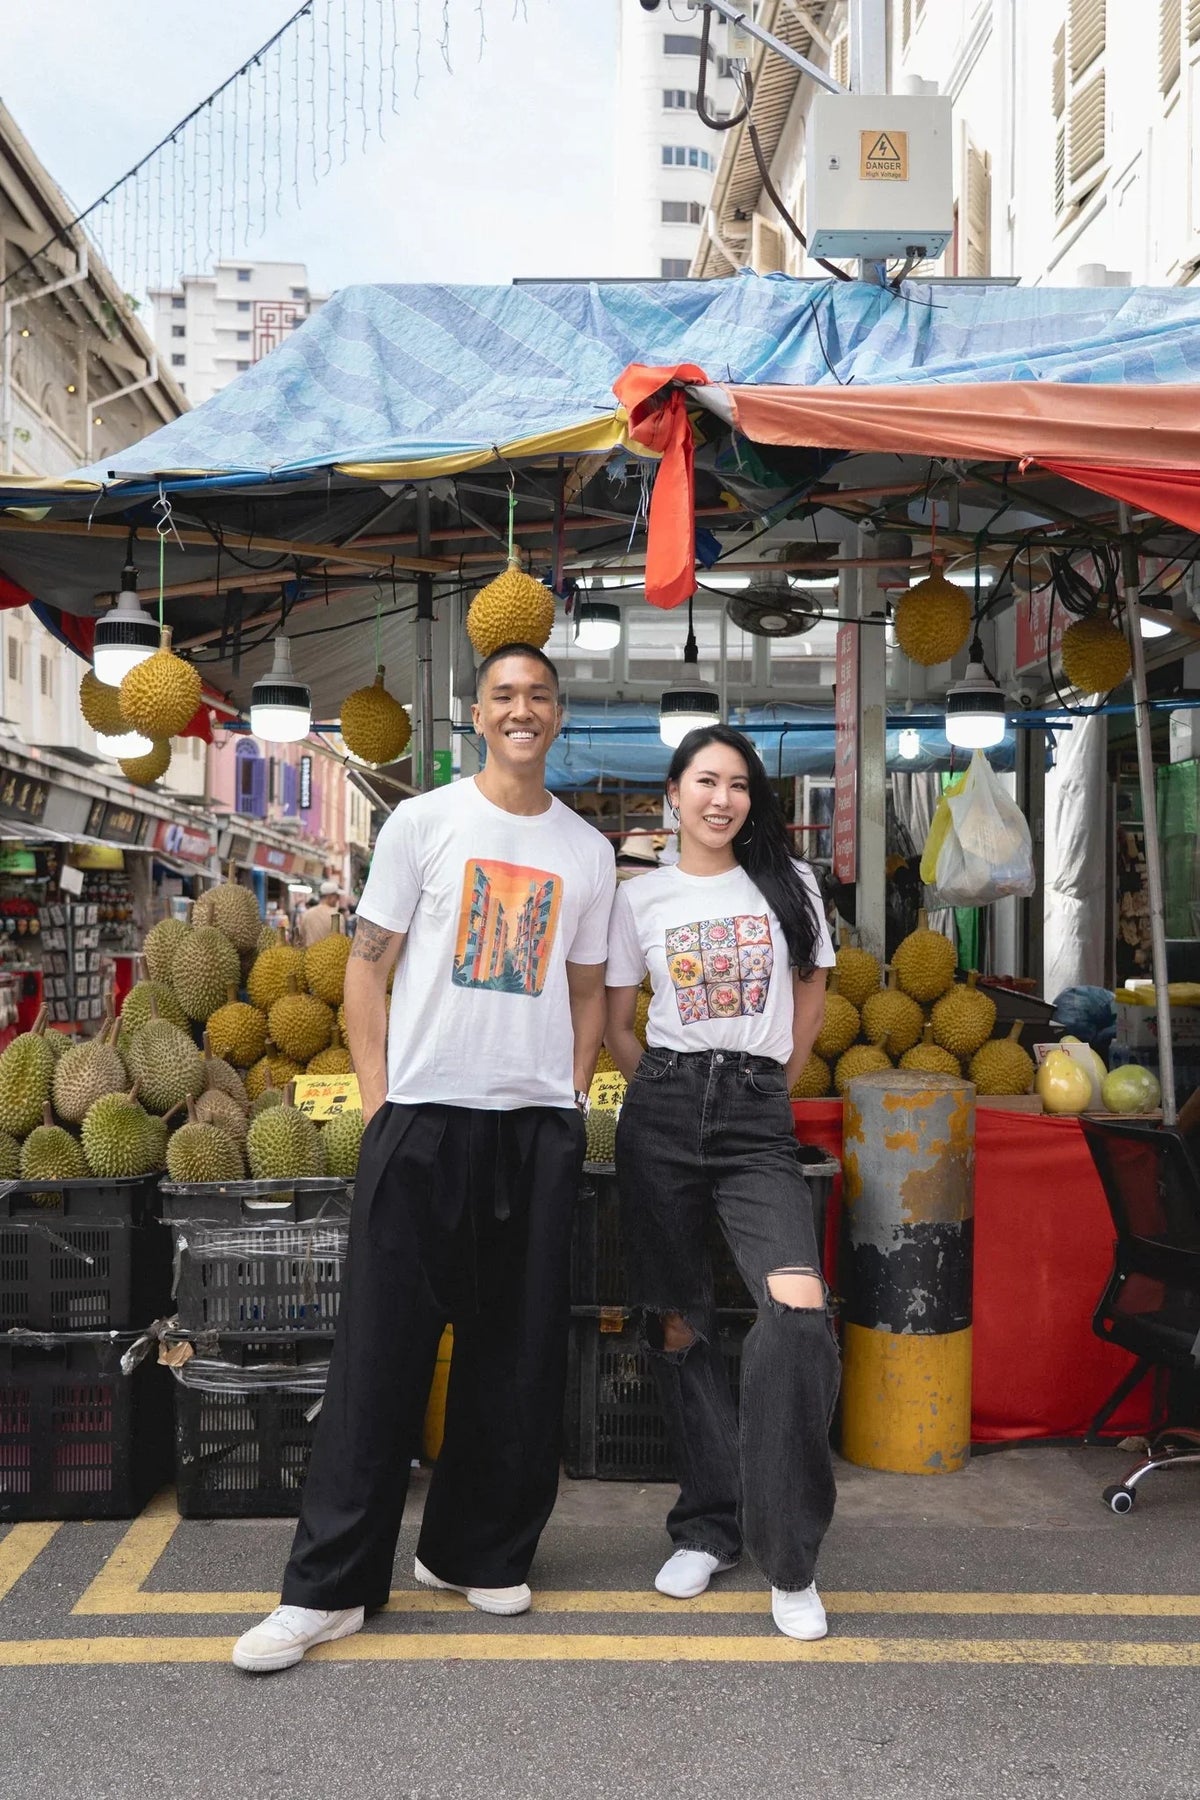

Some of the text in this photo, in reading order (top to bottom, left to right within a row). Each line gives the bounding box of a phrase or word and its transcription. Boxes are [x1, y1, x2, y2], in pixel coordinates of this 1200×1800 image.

[866, 162, 901, 170] DANGER
[1037, 1045, 1070, 1058] Eh
[598, 1083, 622, 1091] BLACK
